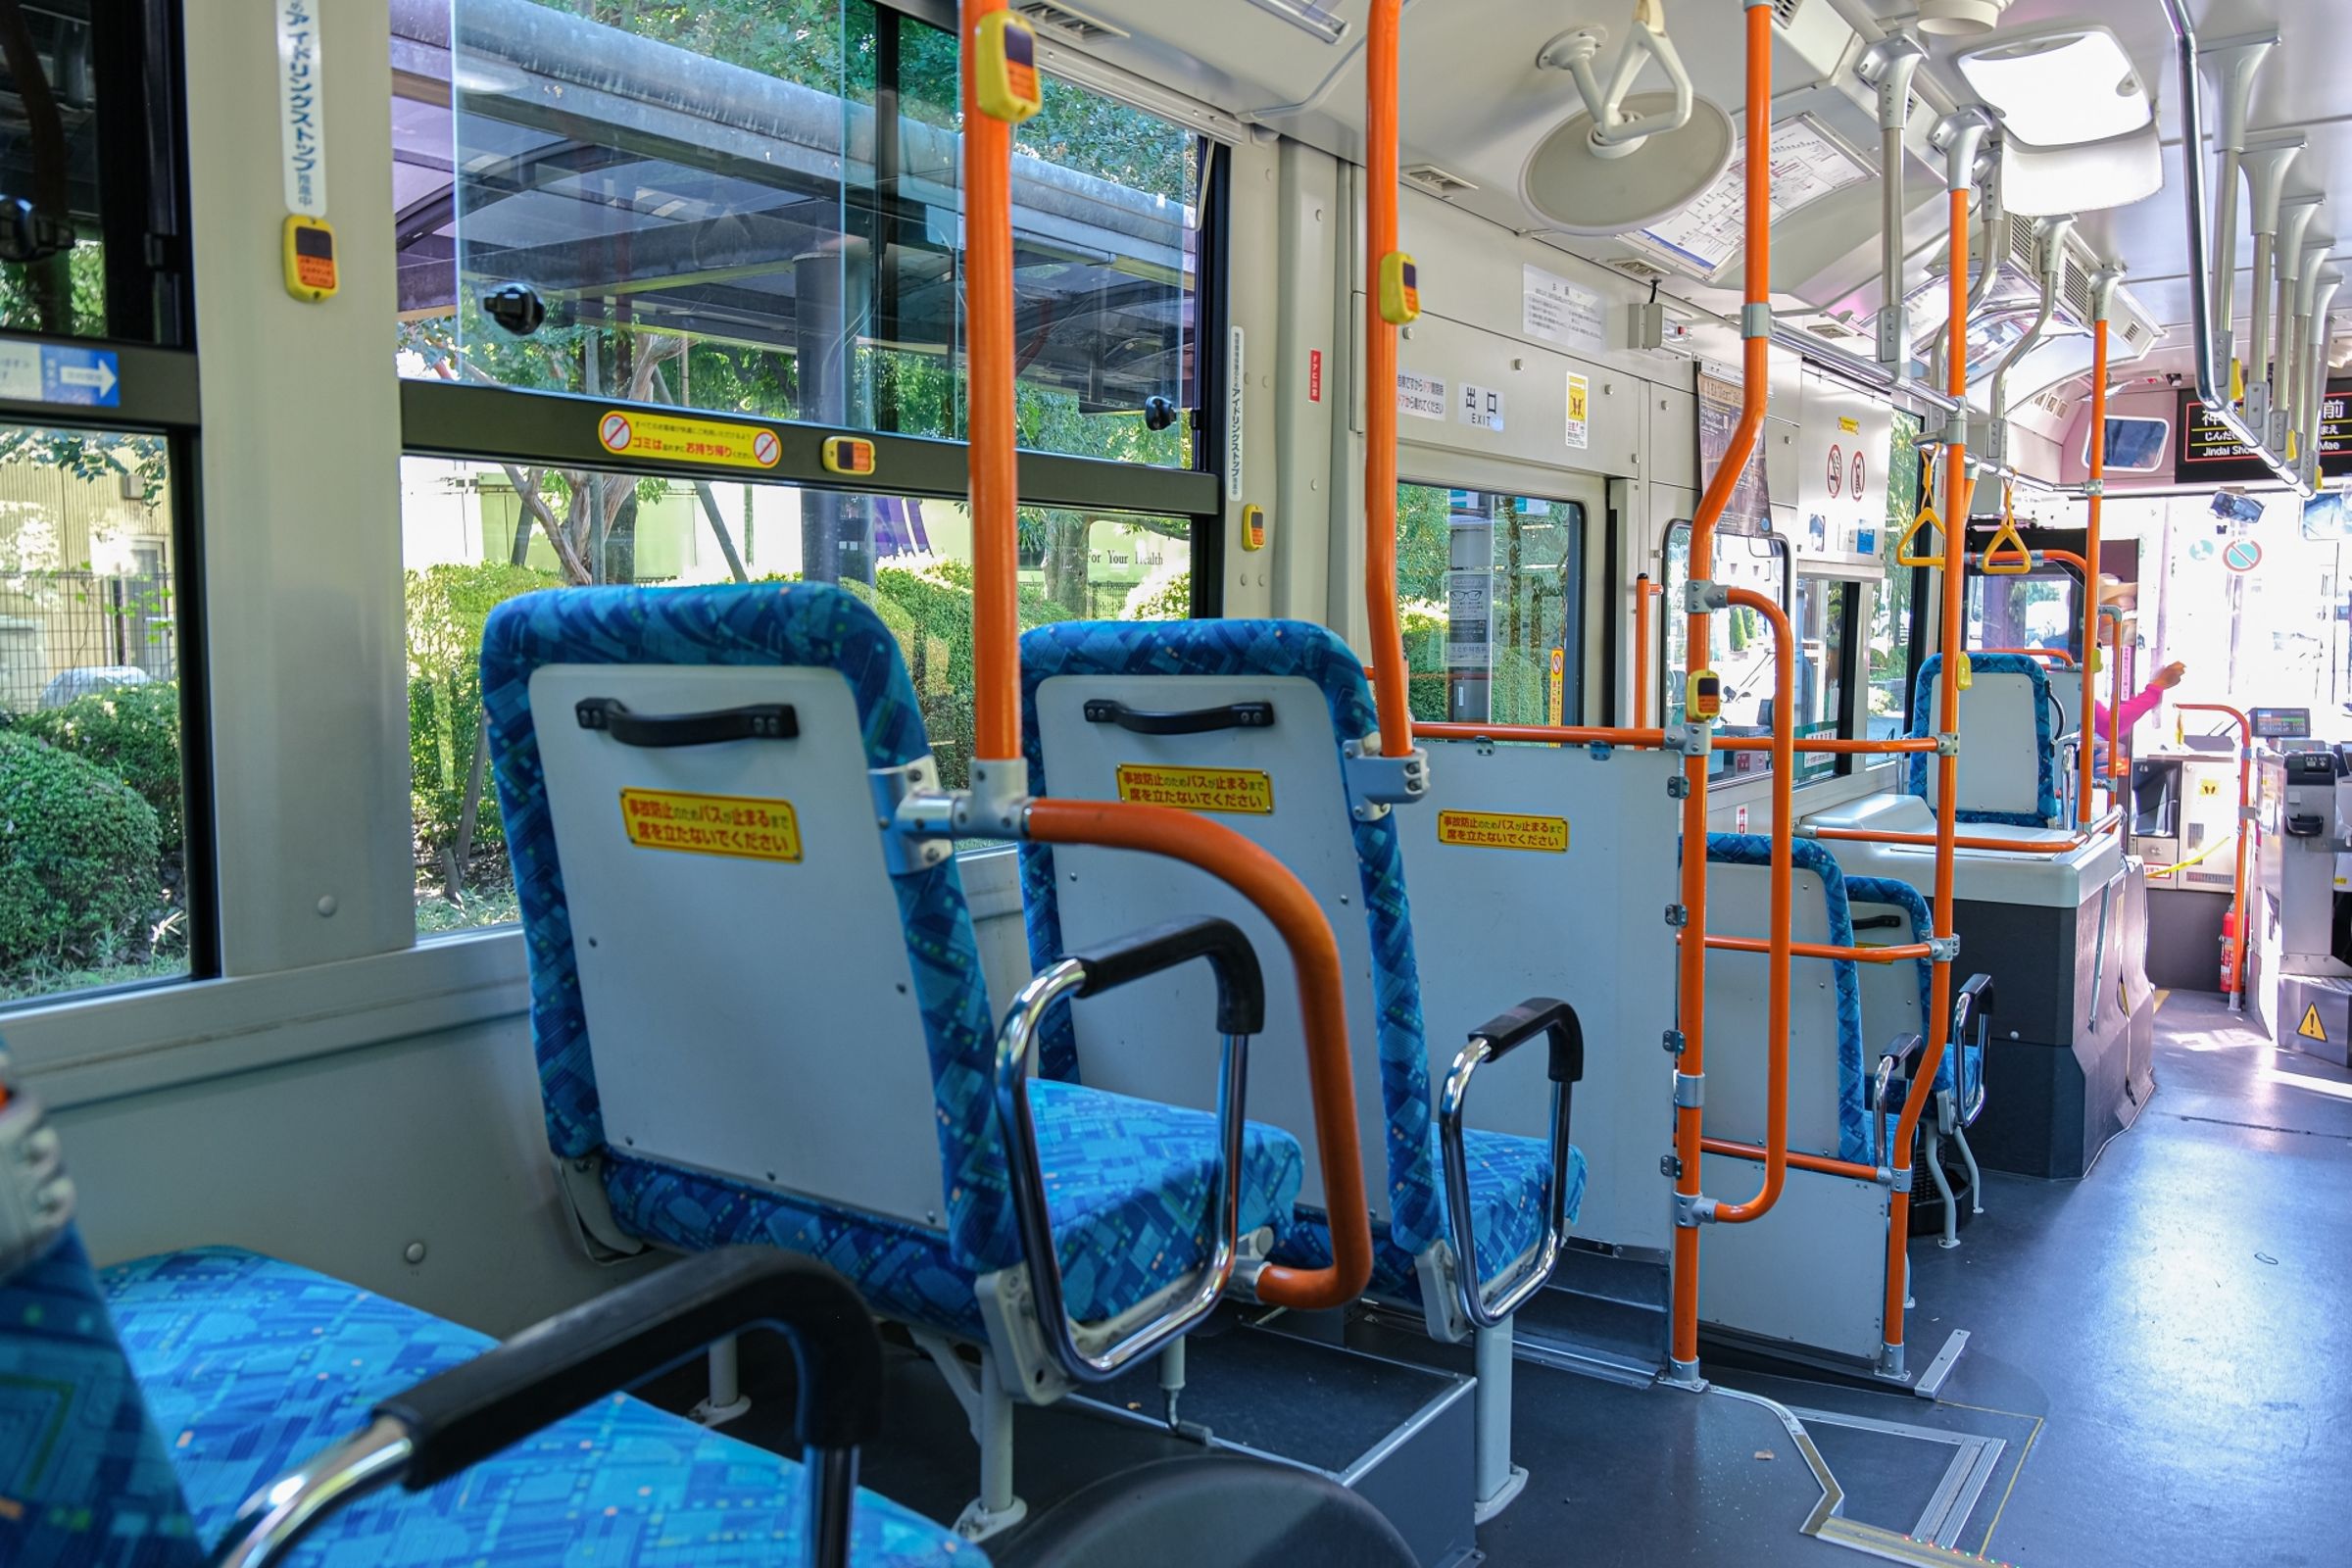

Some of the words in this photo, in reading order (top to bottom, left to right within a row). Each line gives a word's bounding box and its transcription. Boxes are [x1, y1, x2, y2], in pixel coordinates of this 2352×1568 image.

[1465, 386, 1497, 415] 出口
[2323, 399, 2344, 419] 前
[2203, 446, 2230, 457] Jindai
[1088, 550, 1102, 564] or
[1107, 549, 1129, 564] Your
[1130, 788, 1262, 808] 席を立たないでください
[1446, 828, 1559, 846] 席を立たないでください
